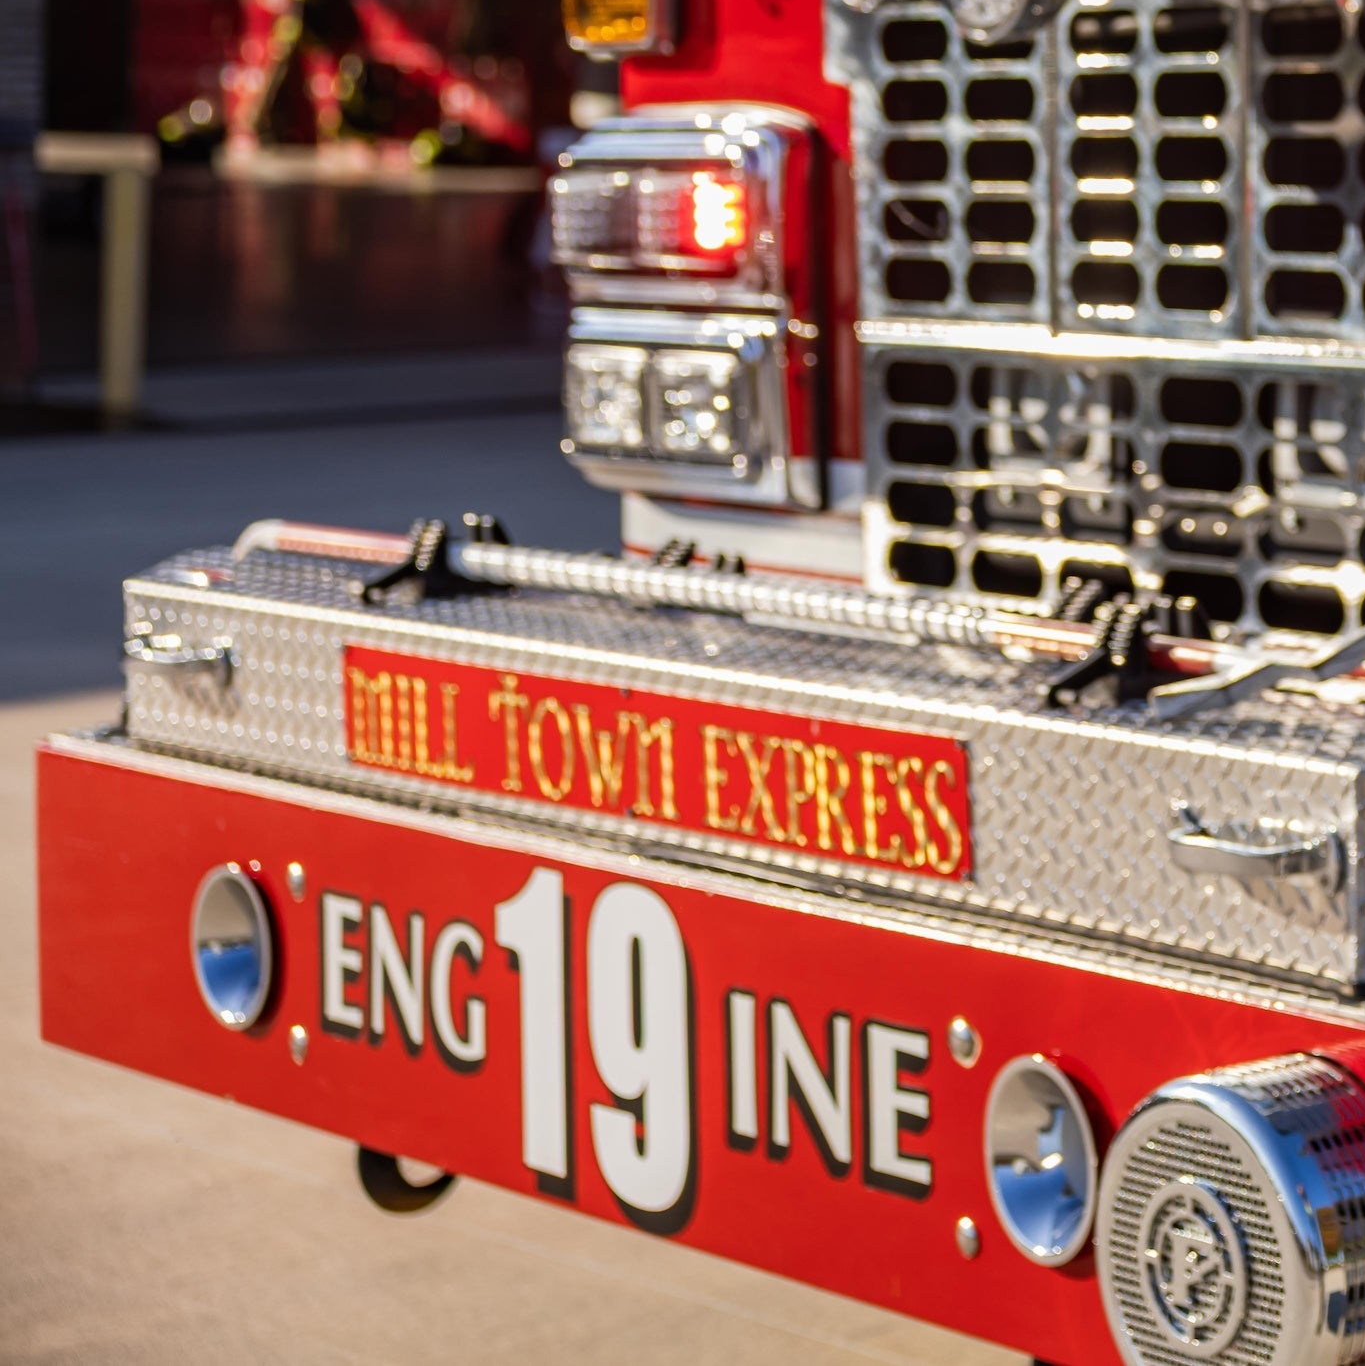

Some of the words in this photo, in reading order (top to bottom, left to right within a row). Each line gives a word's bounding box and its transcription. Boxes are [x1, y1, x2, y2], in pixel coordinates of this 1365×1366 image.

[348, 667, 475, 783] MILL
[703, 724, 963, 875] EXPRESS
[319, 889, 486, 1074] ENG
[494, 864, 696, 1236] 19
[726, 986, 934, 1201] INE
